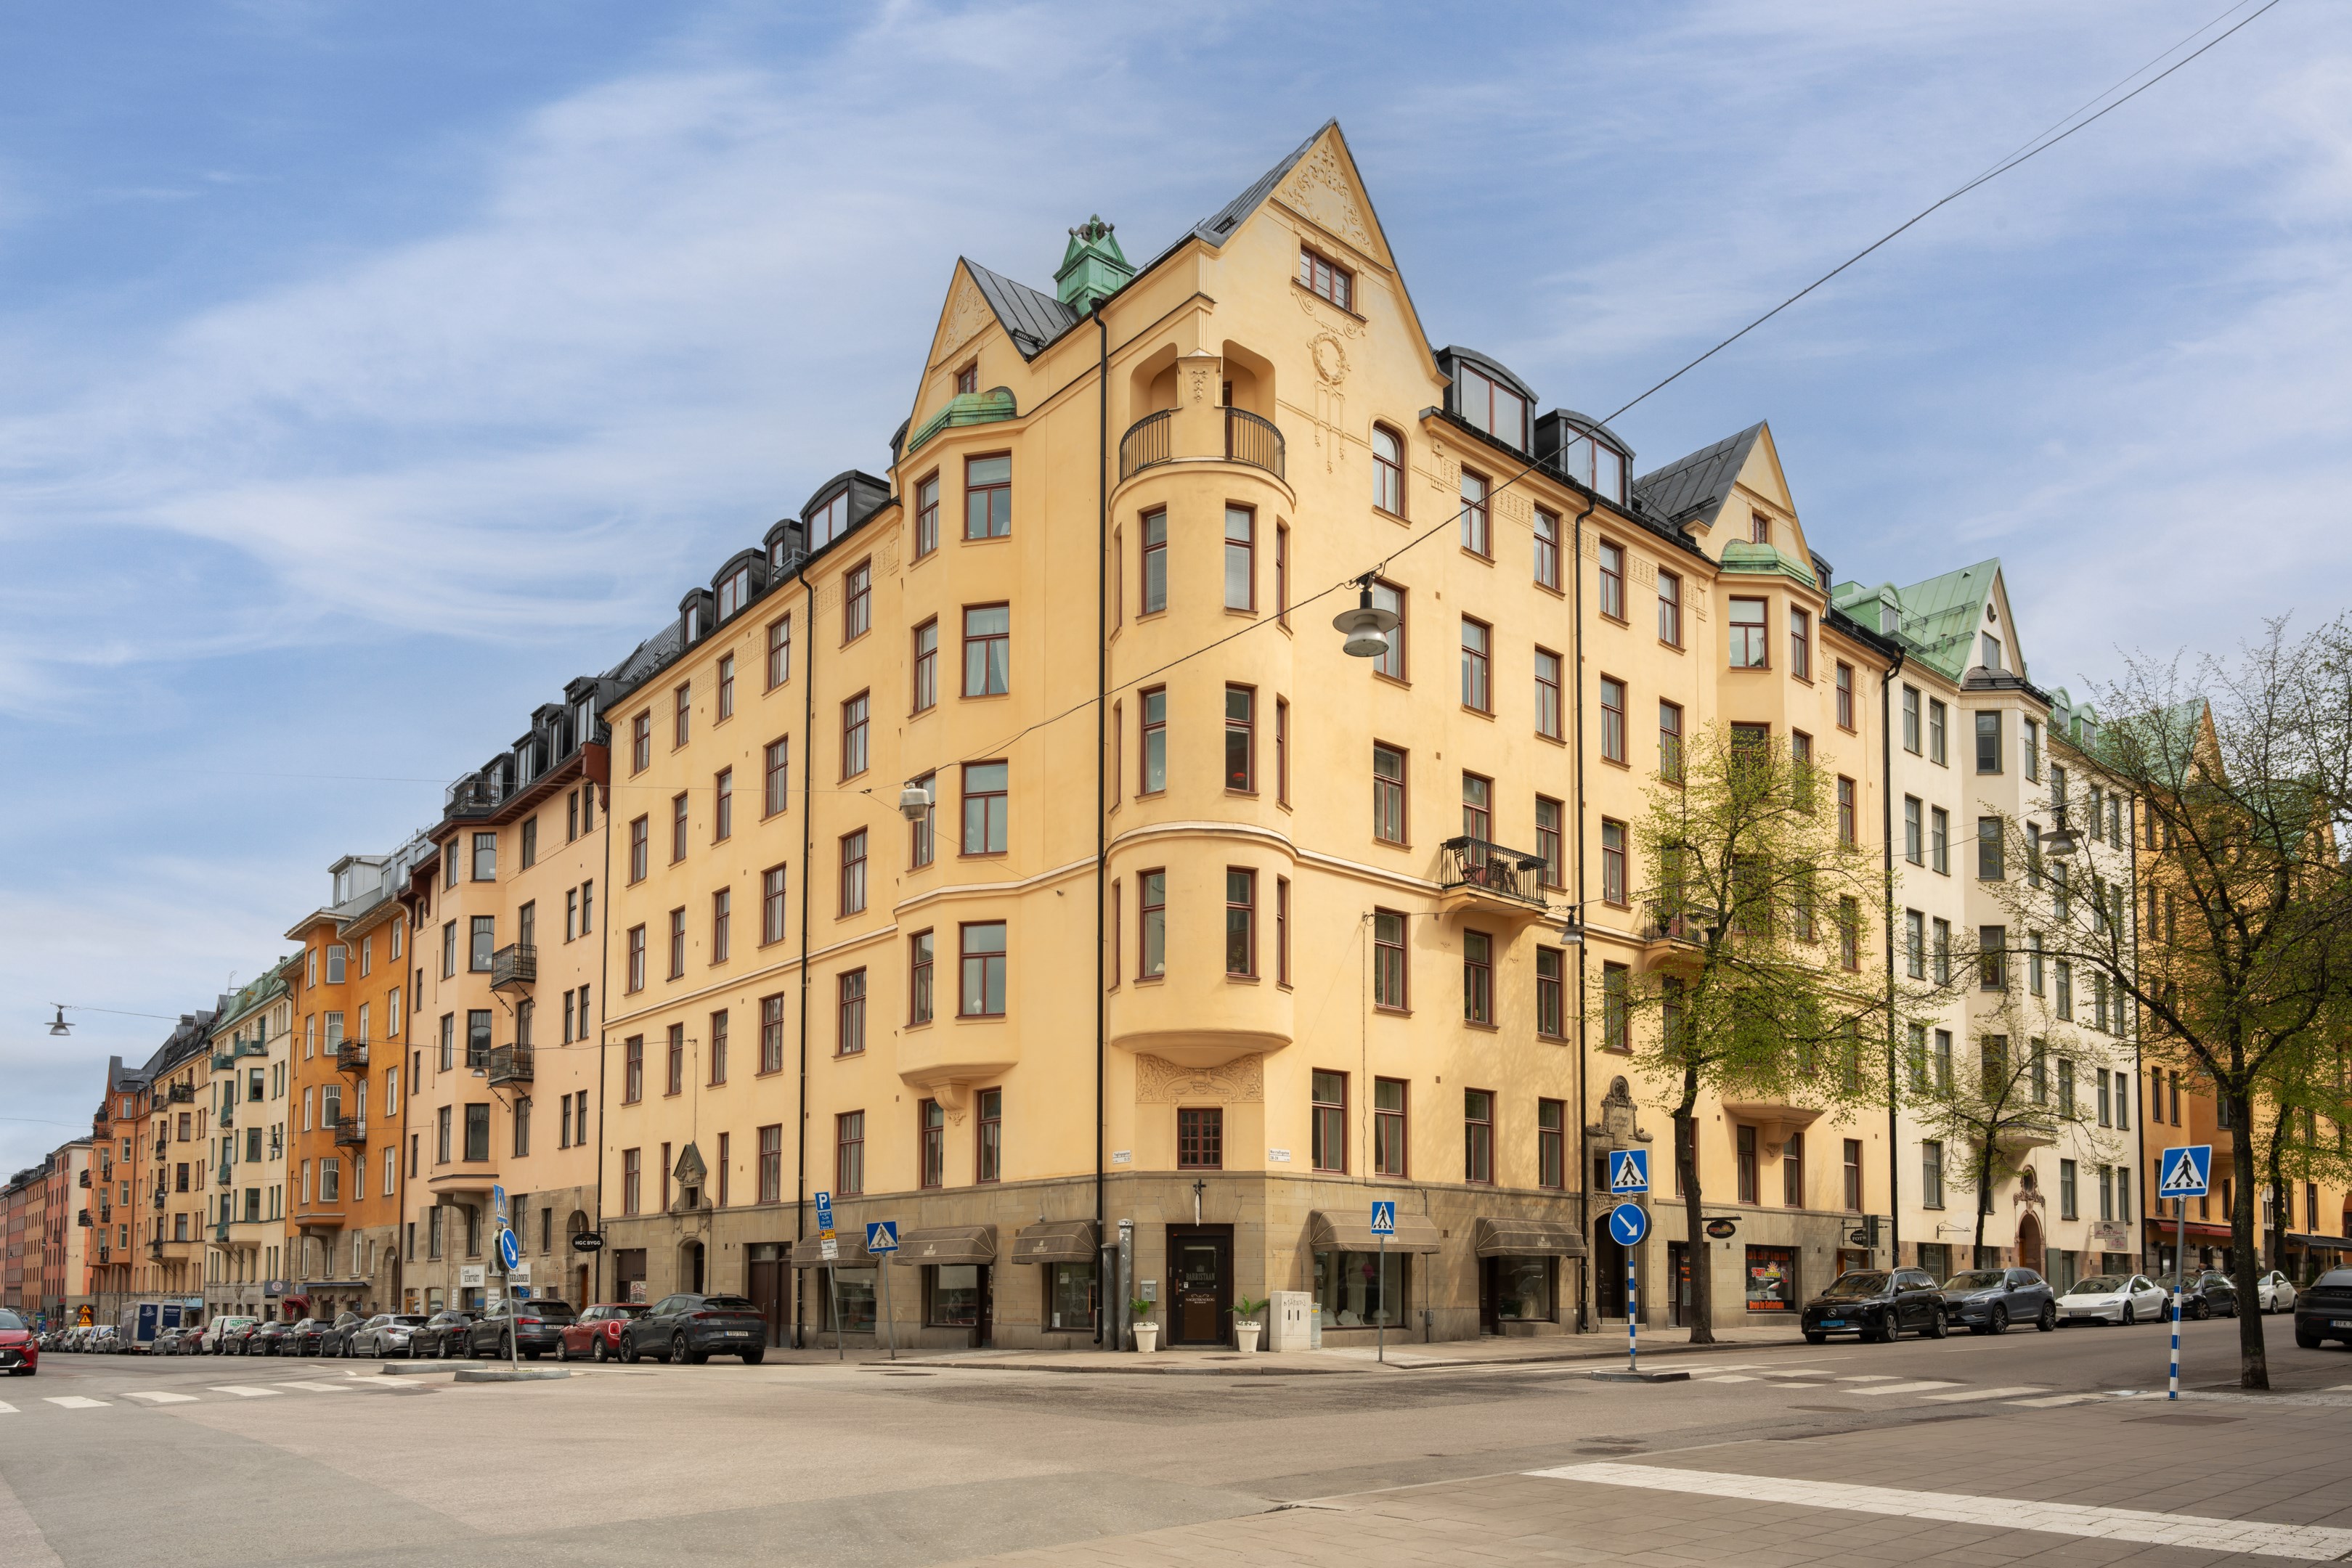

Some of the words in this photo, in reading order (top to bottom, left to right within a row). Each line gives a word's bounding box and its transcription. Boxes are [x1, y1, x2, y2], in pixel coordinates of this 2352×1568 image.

[818, 1193, 828, 1209] P
[1186, 1273, 1215, 1281] BARRISTAAN
[1749, 1300, 1759, 1310] Drop
[1765, 1300, 1784, 1310] Solarium
